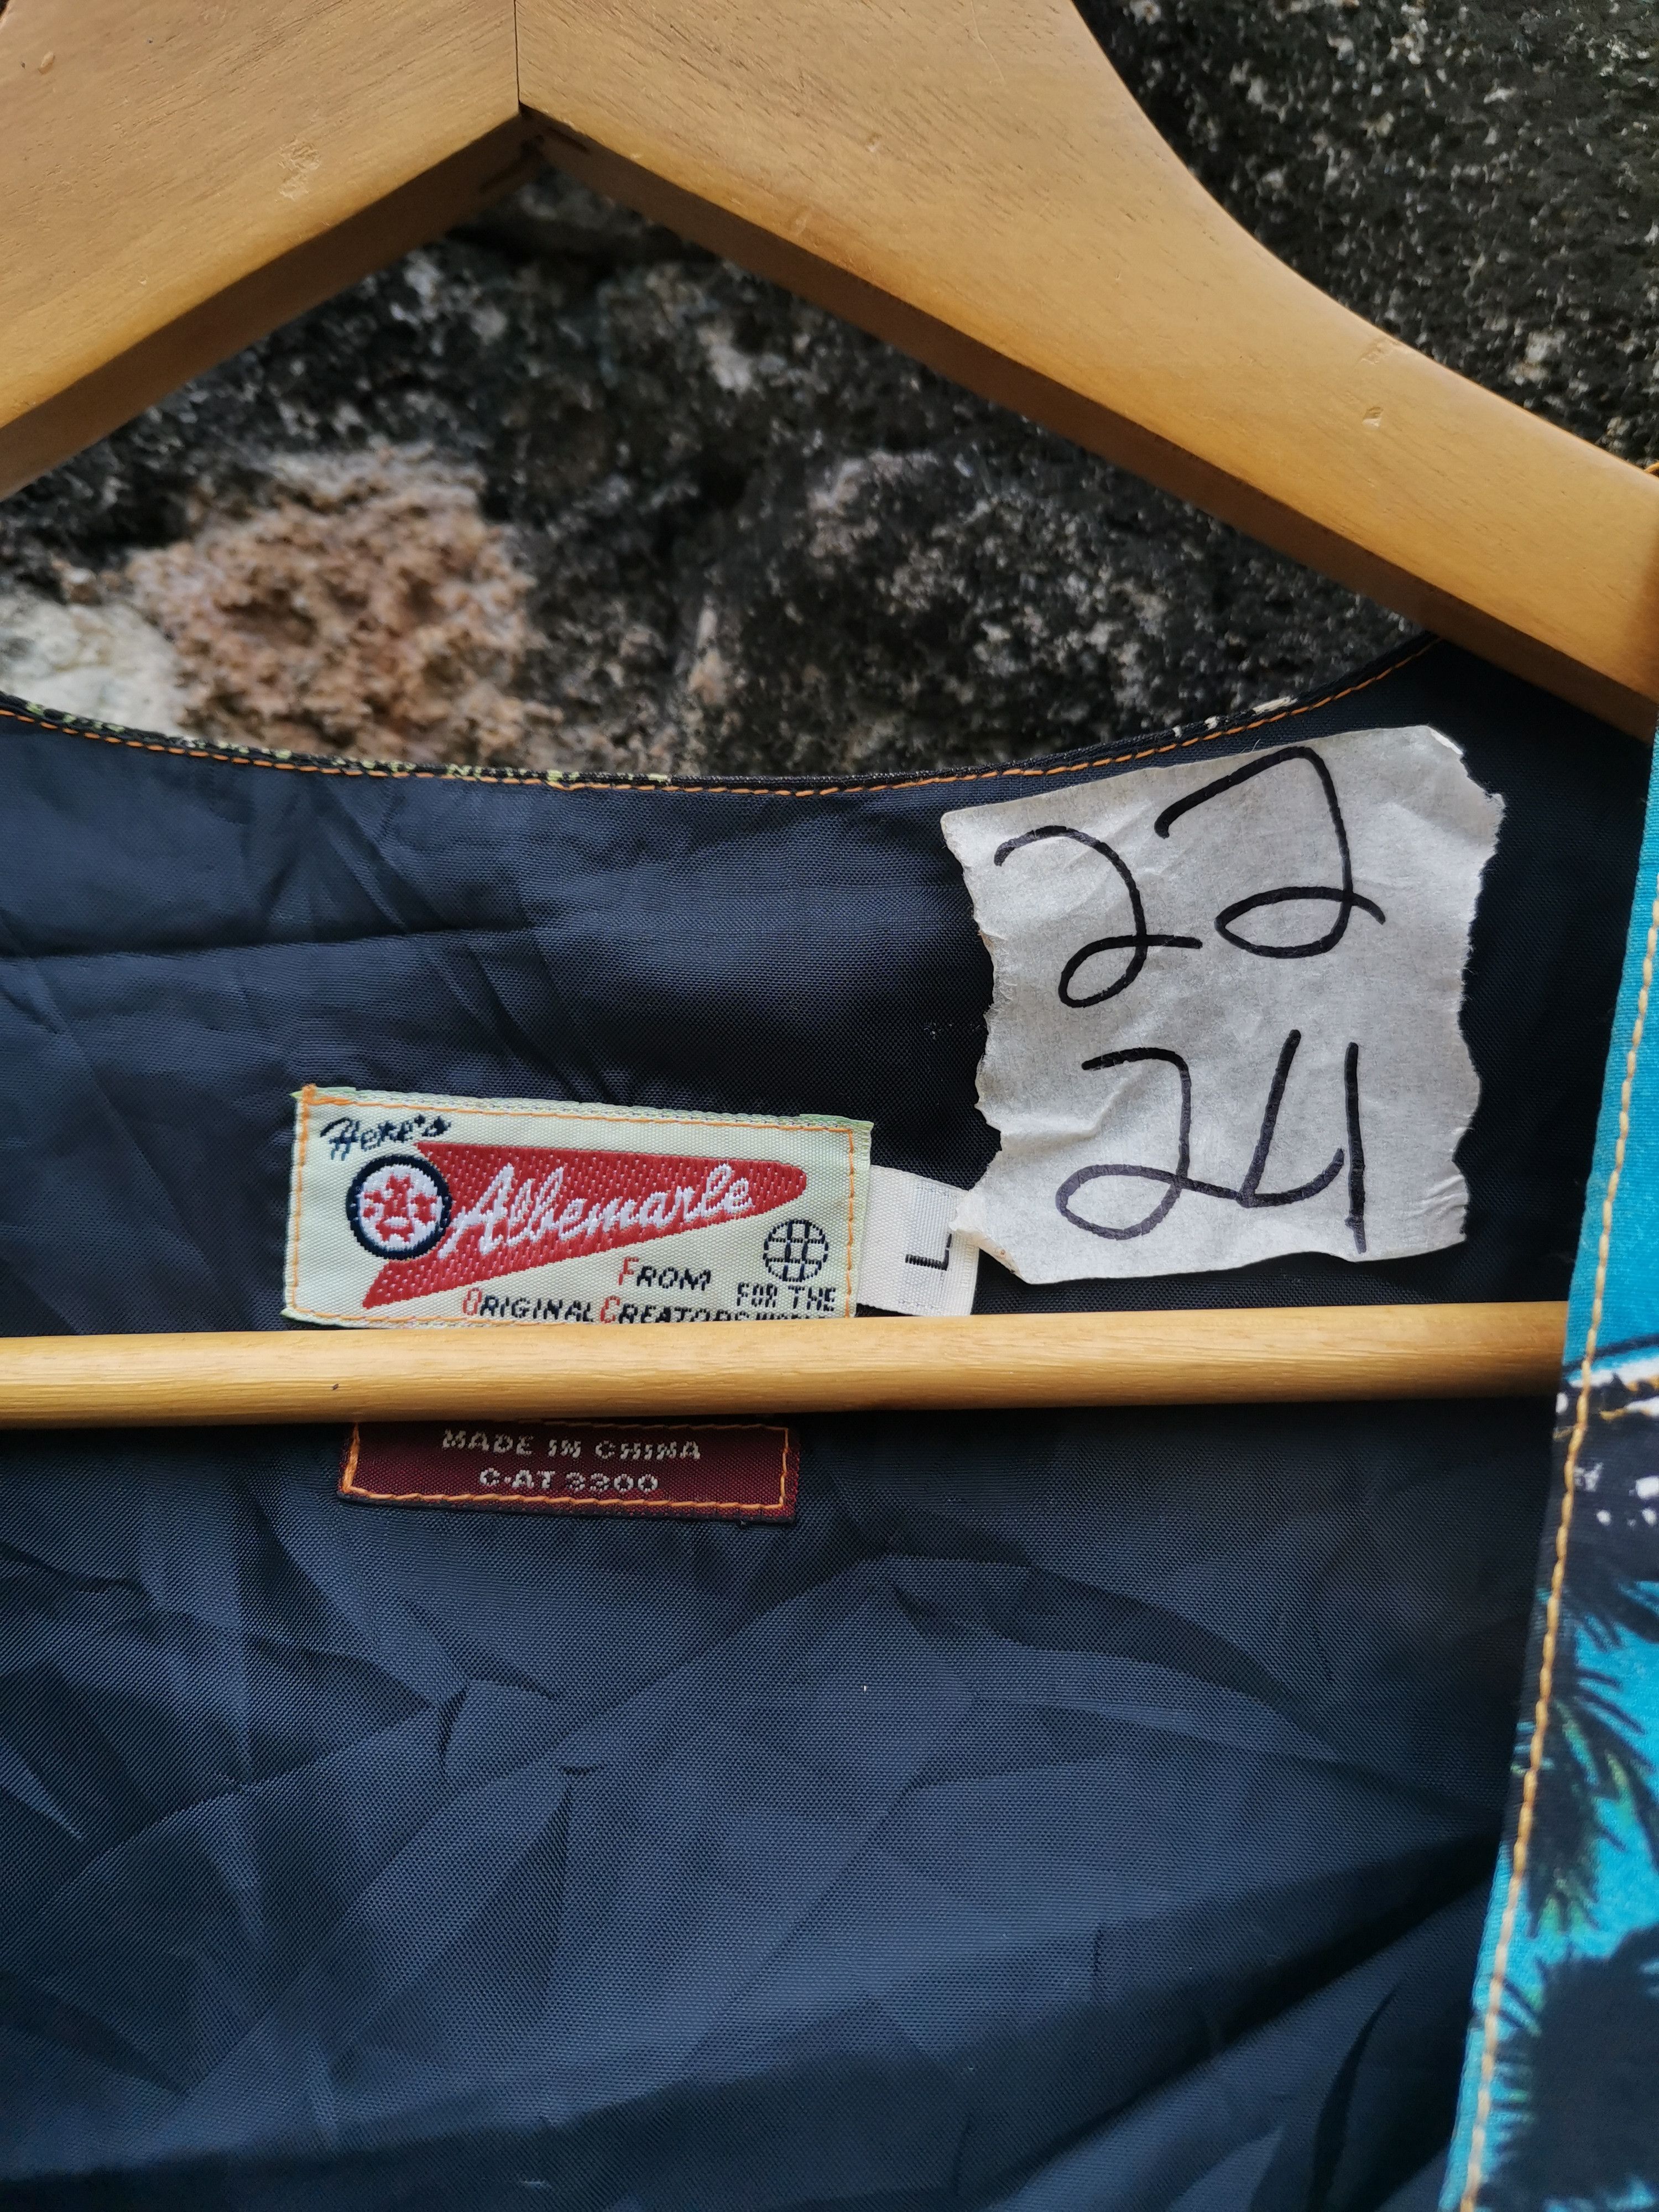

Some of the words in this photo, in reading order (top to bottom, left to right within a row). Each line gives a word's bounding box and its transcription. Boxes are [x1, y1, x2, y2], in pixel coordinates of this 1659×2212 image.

[994, 745, 1386, 1008] 22
[1055, 1029, 1367, 1253] 24
[787, 1285, 836, 1312] THE
[442, 1430, 533, 1457] MADE
[547, 1439, 581, 1458] IN
[594, 1440, 701, 1461] CHINA
